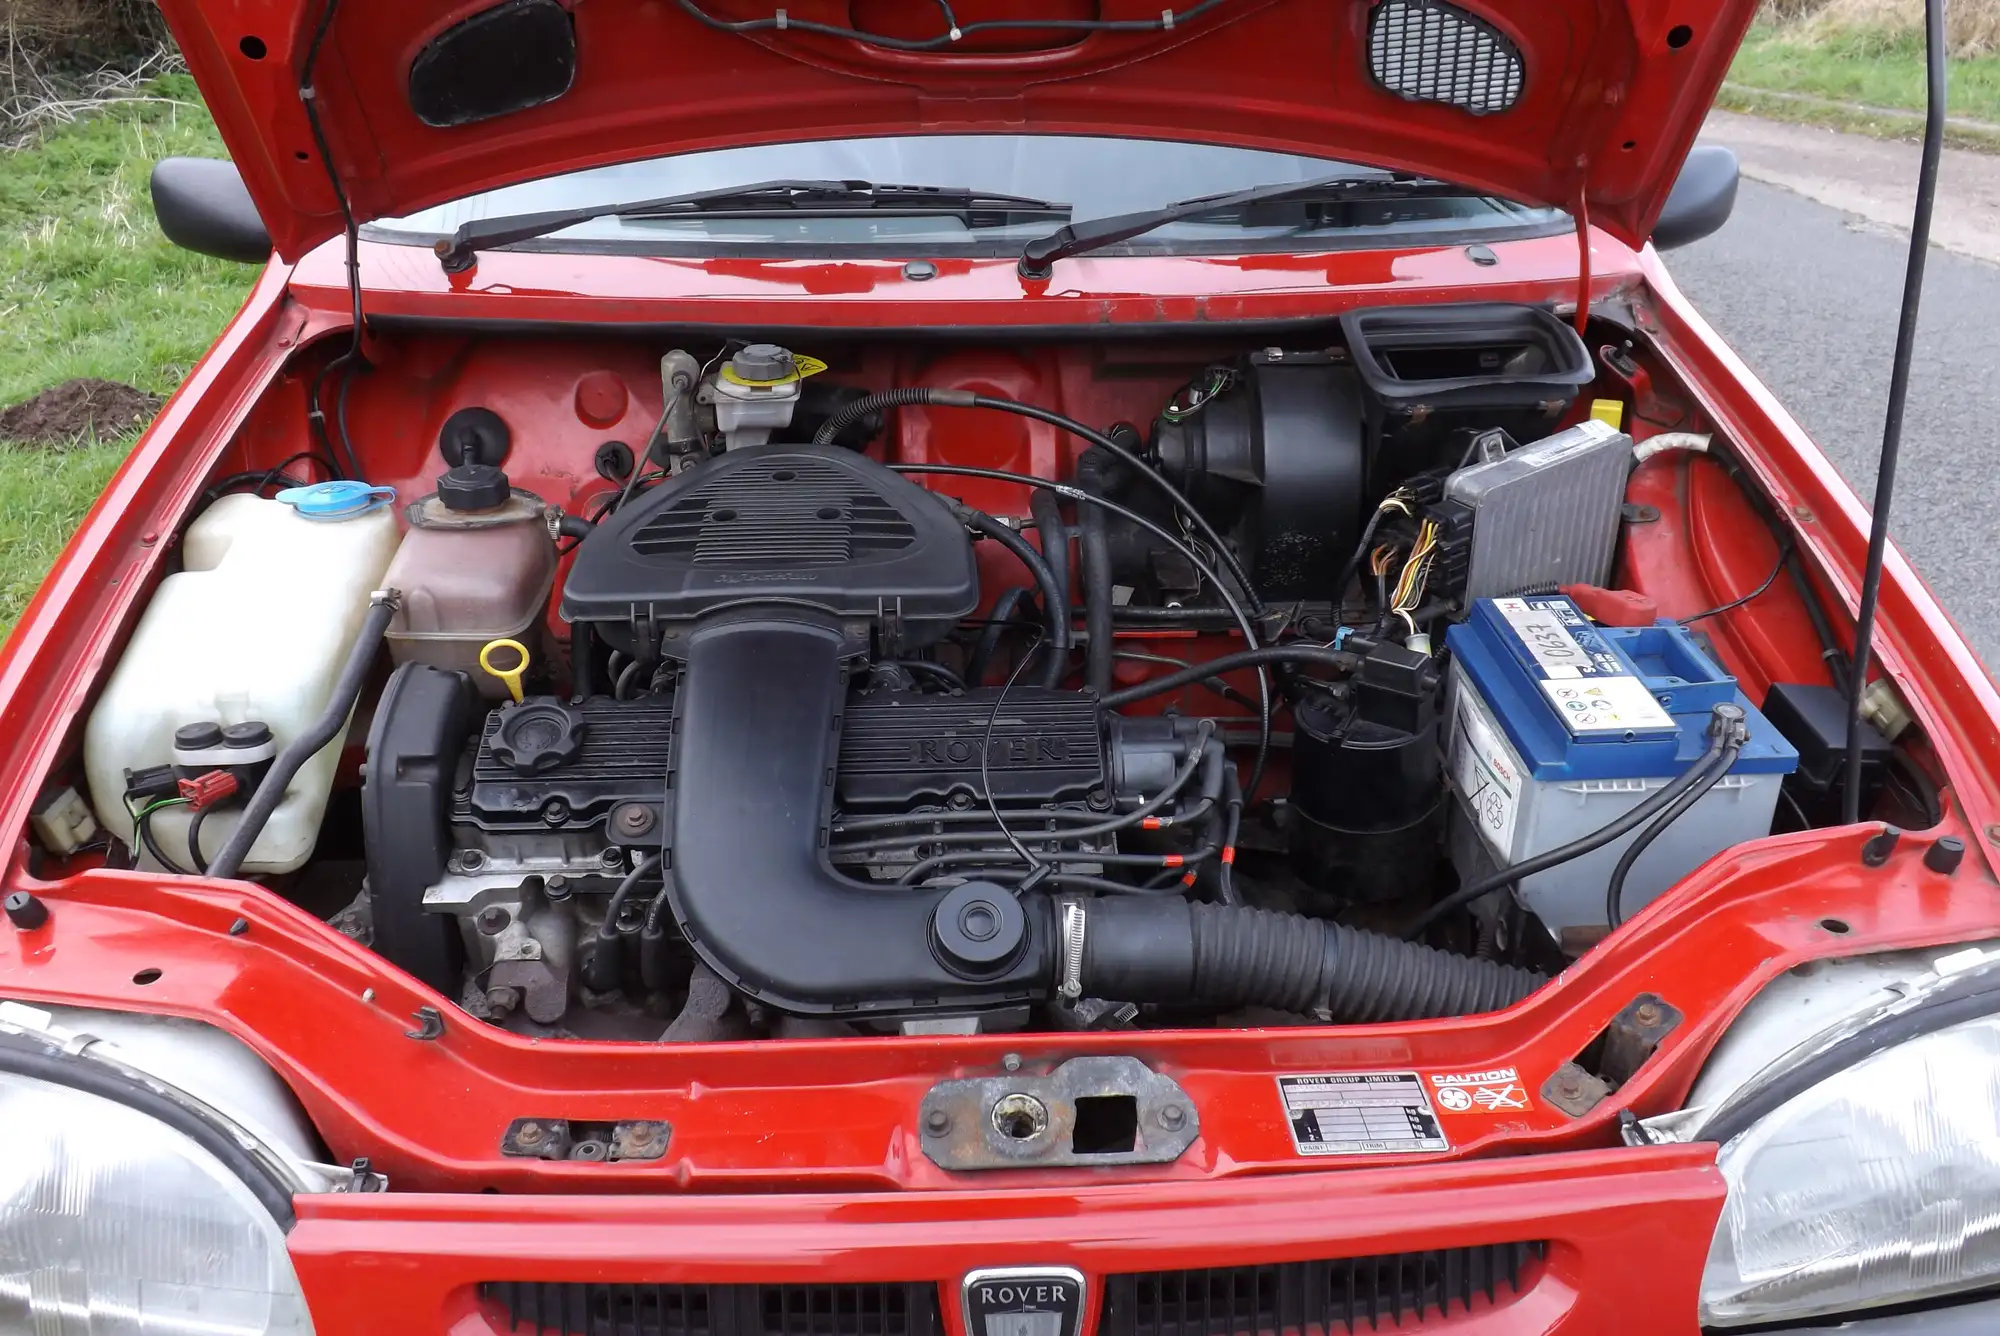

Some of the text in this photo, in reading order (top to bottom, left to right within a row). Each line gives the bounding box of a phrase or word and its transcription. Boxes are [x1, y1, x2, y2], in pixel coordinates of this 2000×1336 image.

[1525, 623, 1575, 658] 0637
[917, 737, 1063, 763] ROVER
[1493, 757, 1511, 784] BOSCH
[1364, 1075, 1400, 1083] LIMITED
[1431, 1068, 1516, 1083] CAUTION
[981, 1285, 1067, 1304] ROVER
